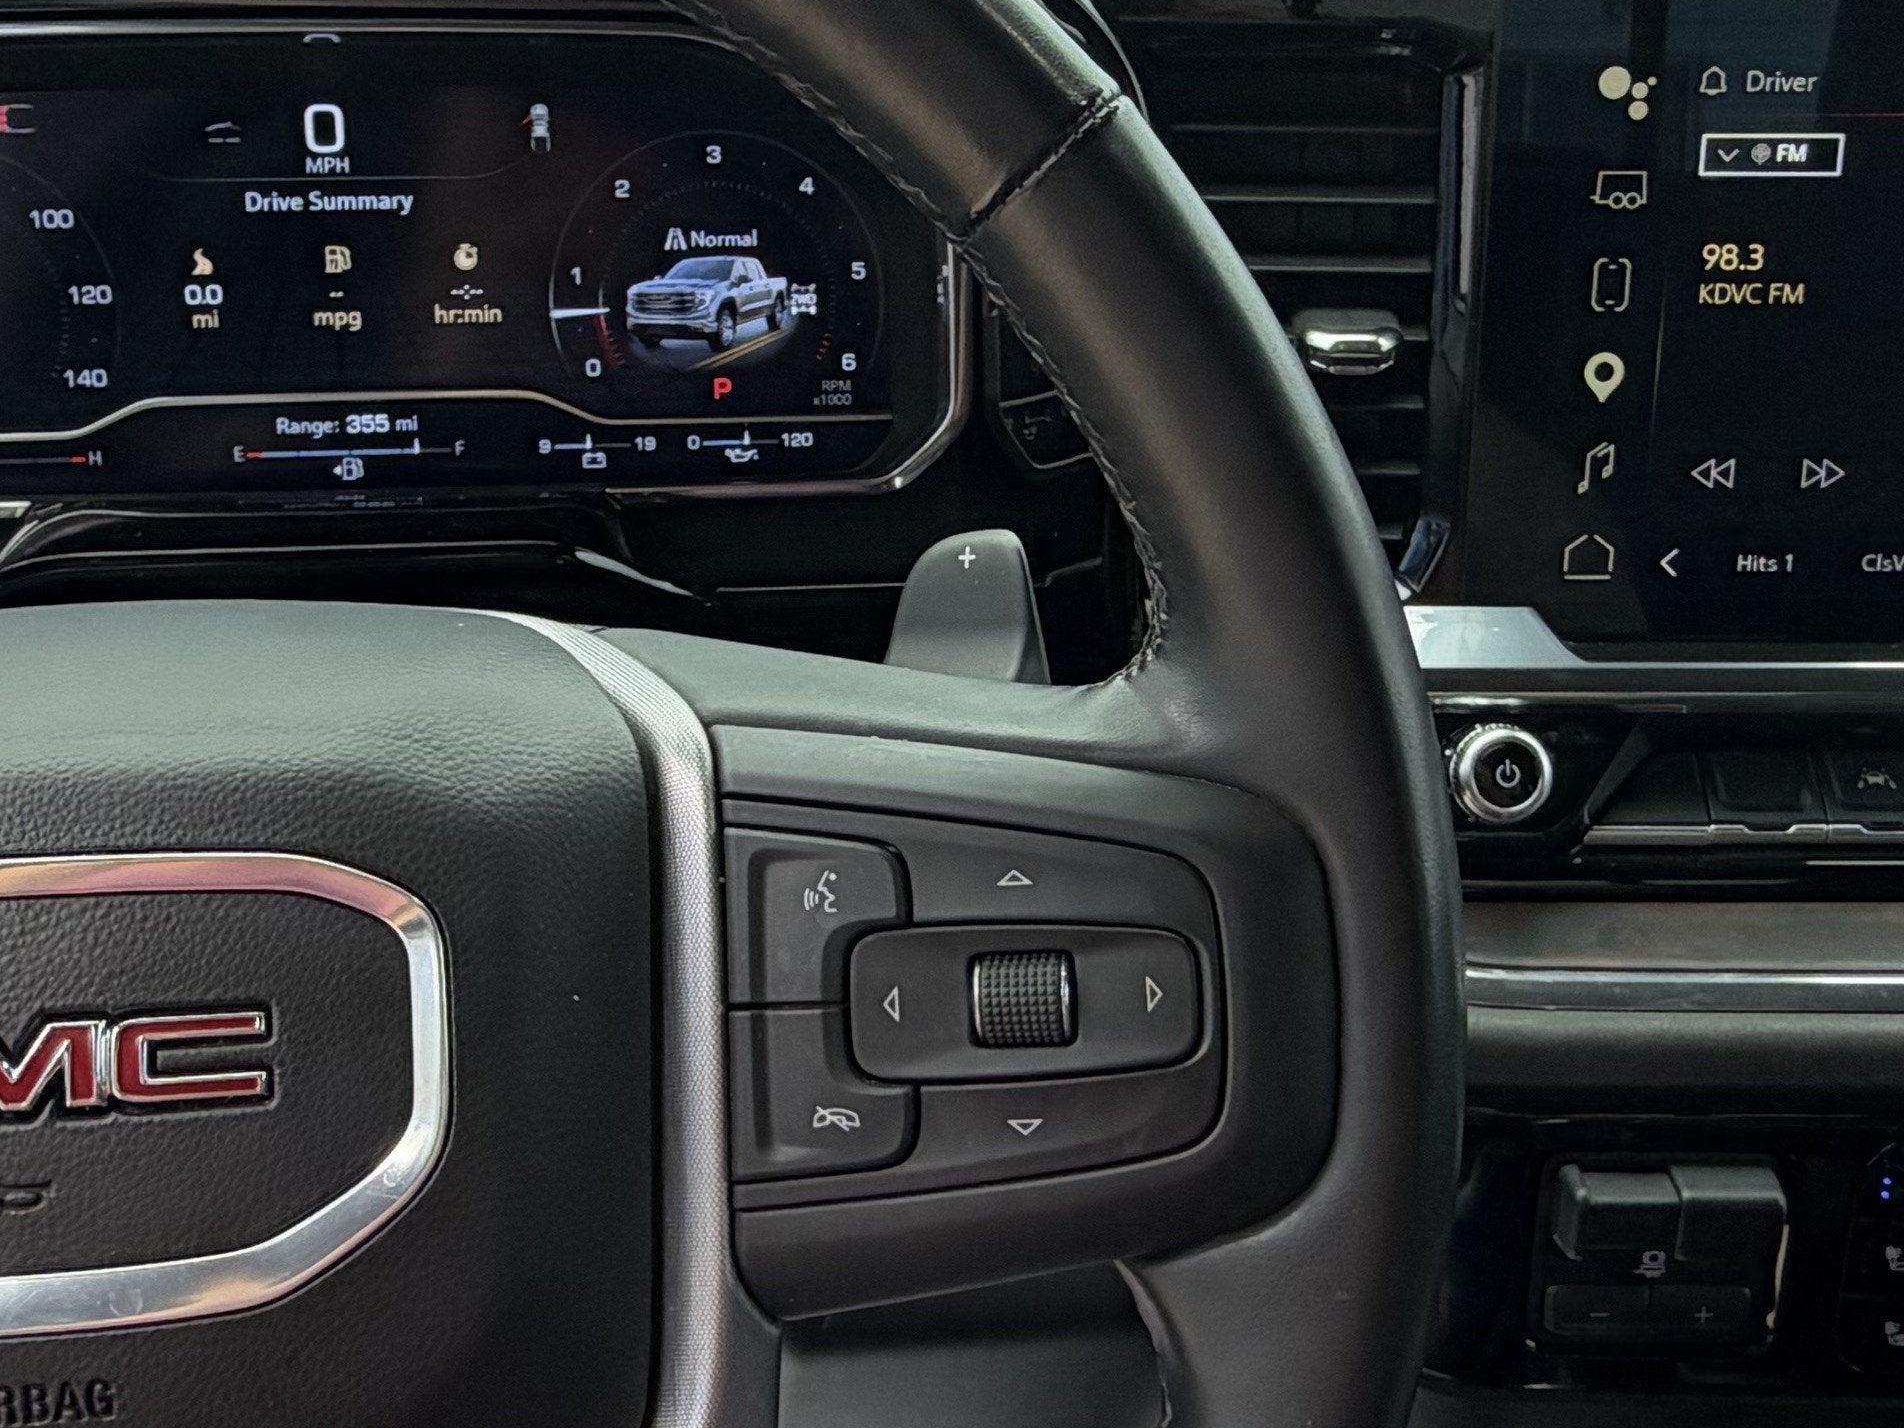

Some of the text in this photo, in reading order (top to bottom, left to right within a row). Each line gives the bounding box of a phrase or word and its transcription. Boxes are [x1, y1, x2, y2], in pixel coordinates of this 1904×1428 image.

[1746, 70, 1819, 93] Driver
[303, 103, 346, 154] 0
[706, 145, 722, 164] 3
[1775, 143, 1809, 163] FM
[305, 157, 350, 174] MPH
[614, 179, 631, 198] 2
[798, 176, 815, 195] 4
[245, 190, 414, 216] Drive Summary
[29, 208, 75, 229] 100
[690, 228, 758, 249] Normal
[1701, 243, 1766, 272] 98.3
[570, 267, 582, 285] 1
[850, 262, 867, 280] 5
[67, 284, 113, 305] 120
[184, 284, 224, 306] 0.0
[1698, 282, 1806, 305] KDVC FM
[192, 309, 220, 329] mi
[313, 310, 363, 332] mpg
[585, 359, 602, 377] 0
[841, 353, 857, 371] 6
[63, 369, 108, 389] 140
[713, 377, 733, 400] P
[821, 380, 852, 392] RPM
[275, 413, 418, 439] Range: 355 mi
[454, 439, 465, 456] F
[538, 439, 552, 454] 9
[634, 436, 657, 452] 19
[687, 435, 701, 450] 0
[780, 432, 814, 448] 120
[88, 451, 102, 466] H
[233, 445, 245, 463] E
[1736, 554, 1794, 573] Hits 1
